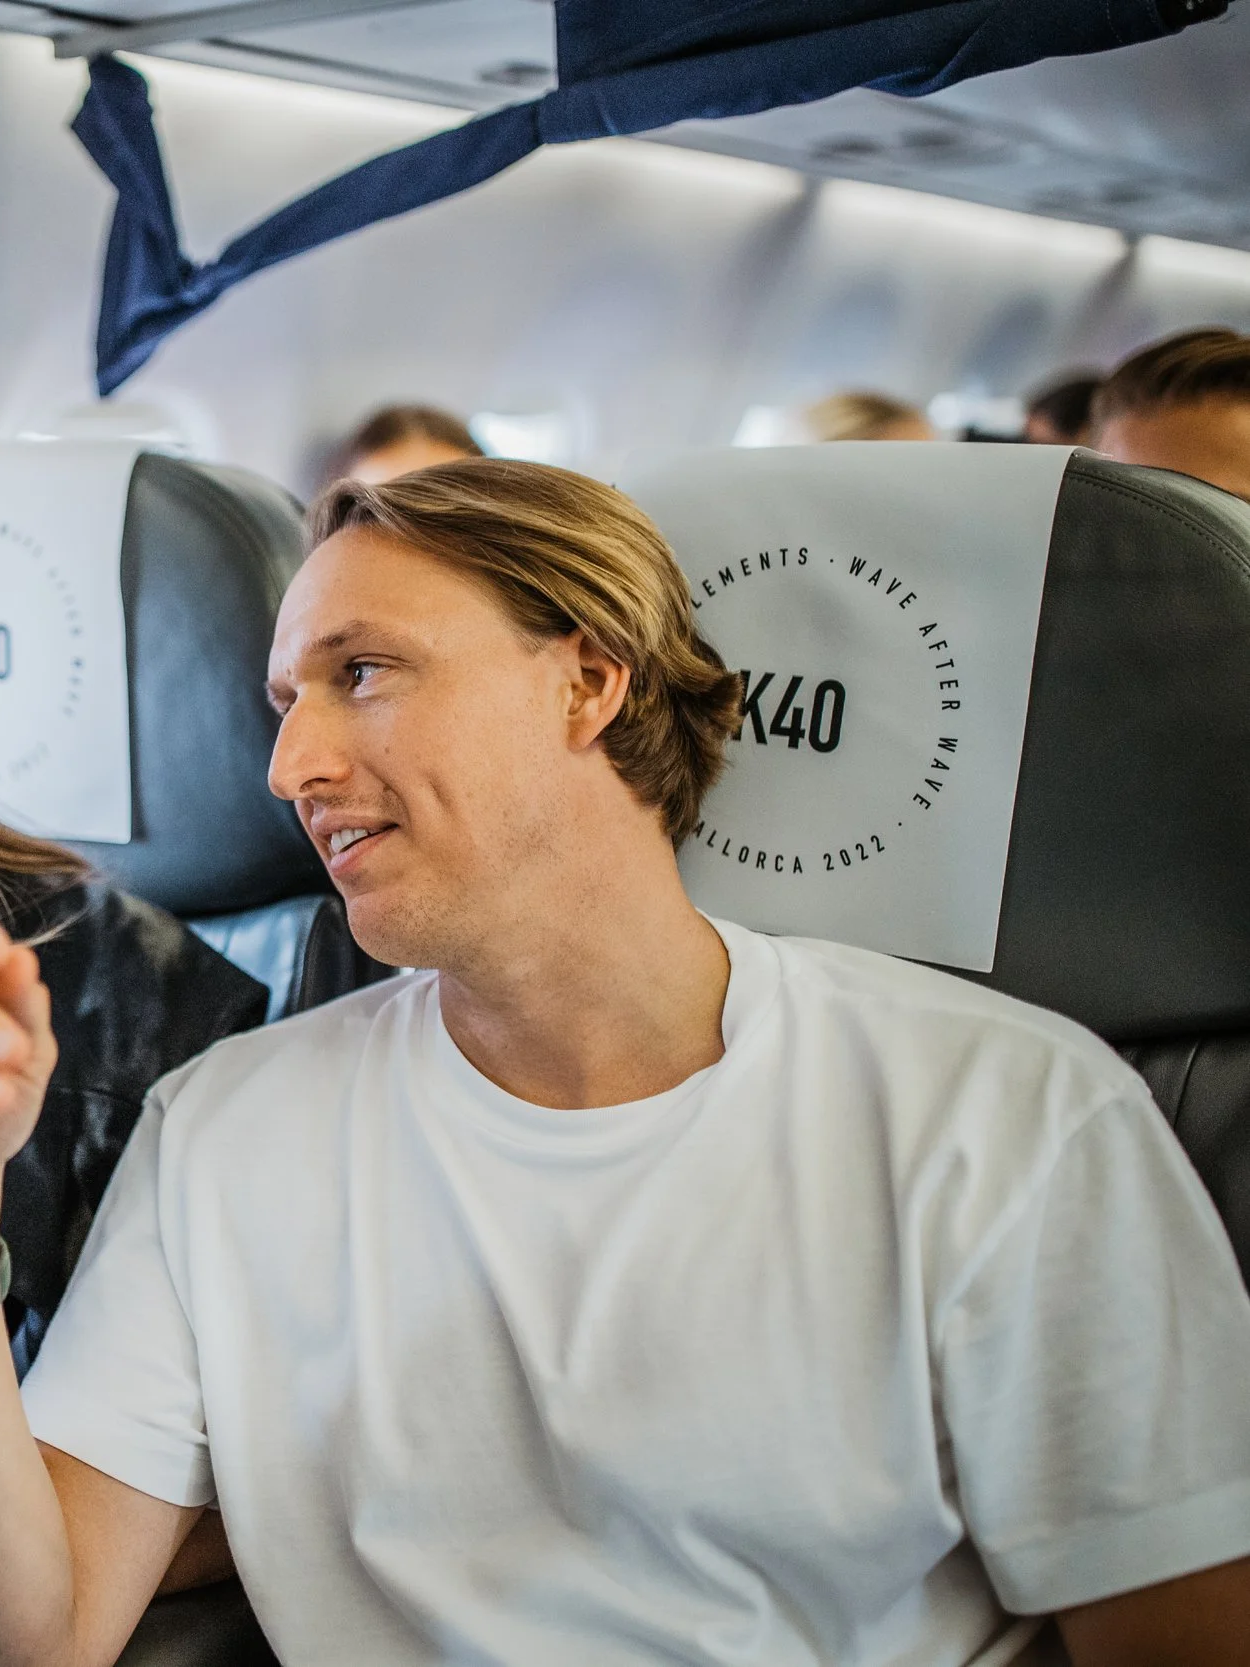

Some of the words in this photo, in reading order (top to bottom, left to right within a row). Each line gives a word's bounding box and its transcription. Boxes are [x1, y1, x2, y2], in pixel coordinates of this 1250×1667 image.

[689, 547, 808, 610] LEMENTS
[849, 556, 918, 610] WAVE
[918, 622, 961, 711] AFTER
[912, 737, 959, 810] WAVE
[695, 820, 803, 874] ALLORCA
[822, 834, 886, 871] 2022
